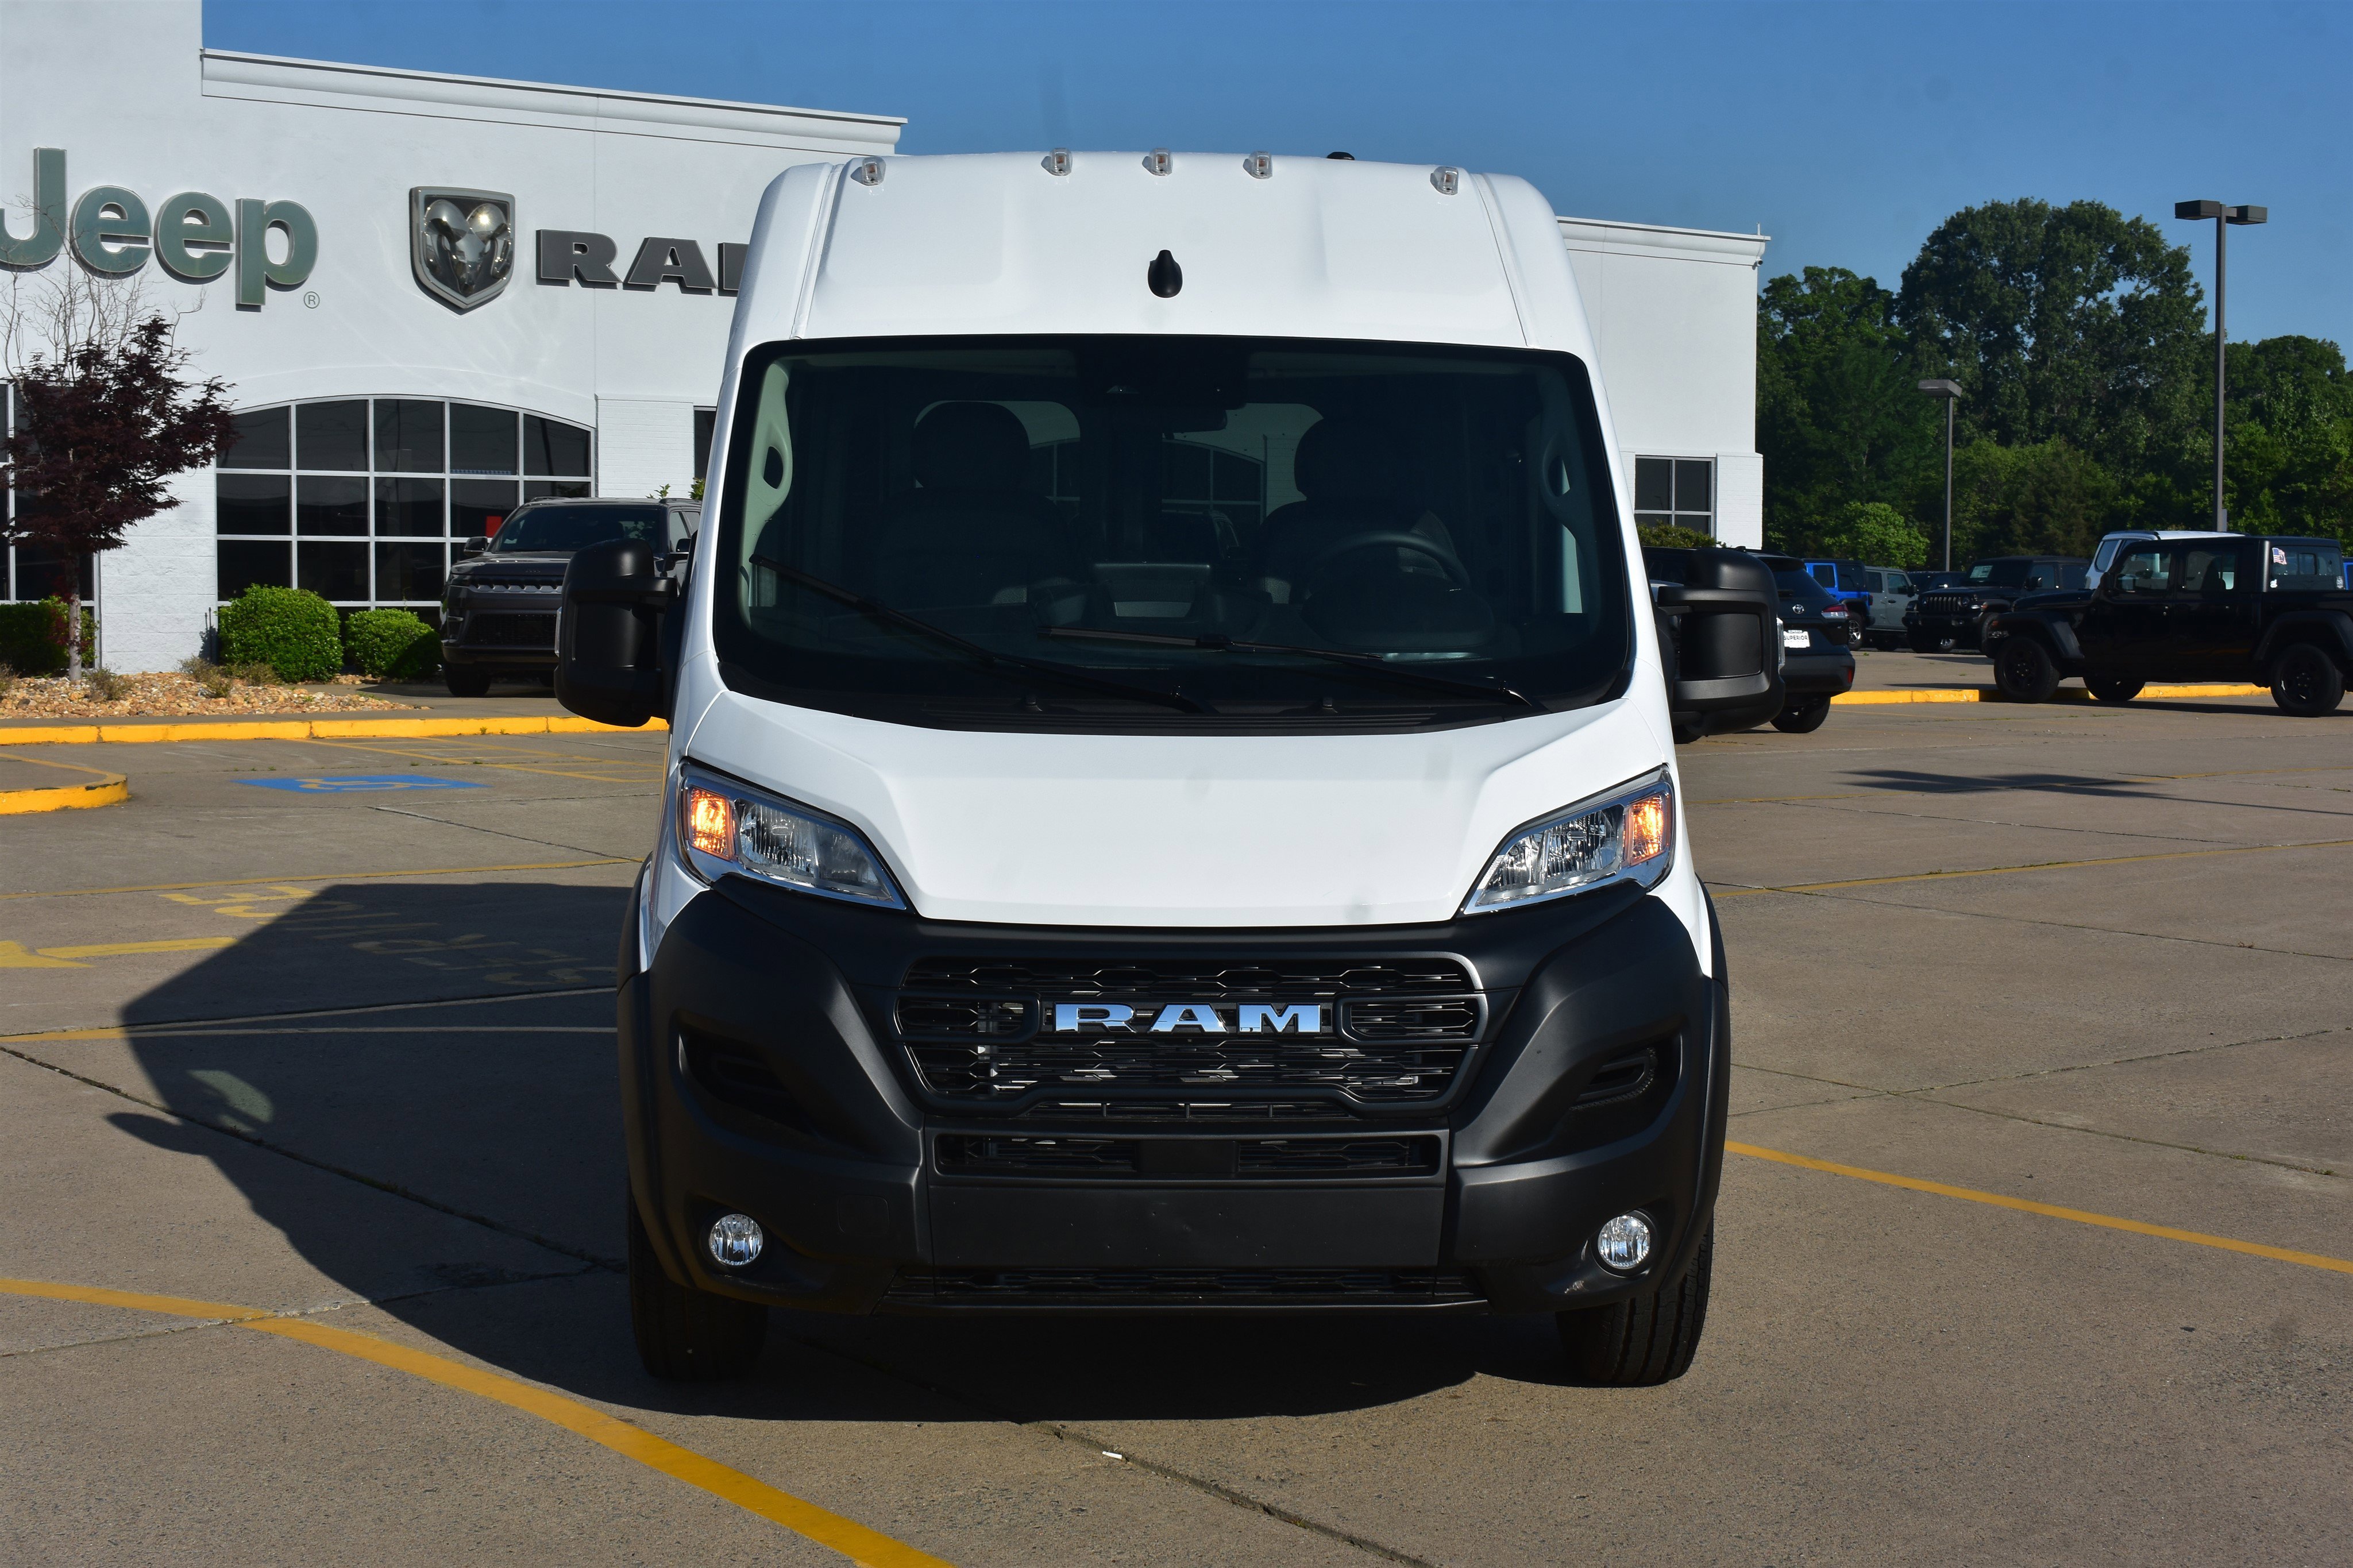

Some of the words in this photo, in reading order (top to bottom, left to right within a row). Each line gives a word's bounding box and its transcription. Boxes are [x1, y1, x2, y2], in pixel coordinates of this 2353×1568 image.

[0, 147, 319, 306] Jeep
[159, 886, 618, 986] SERVICE
[1052, 1002, 1322, 1033] RAM
